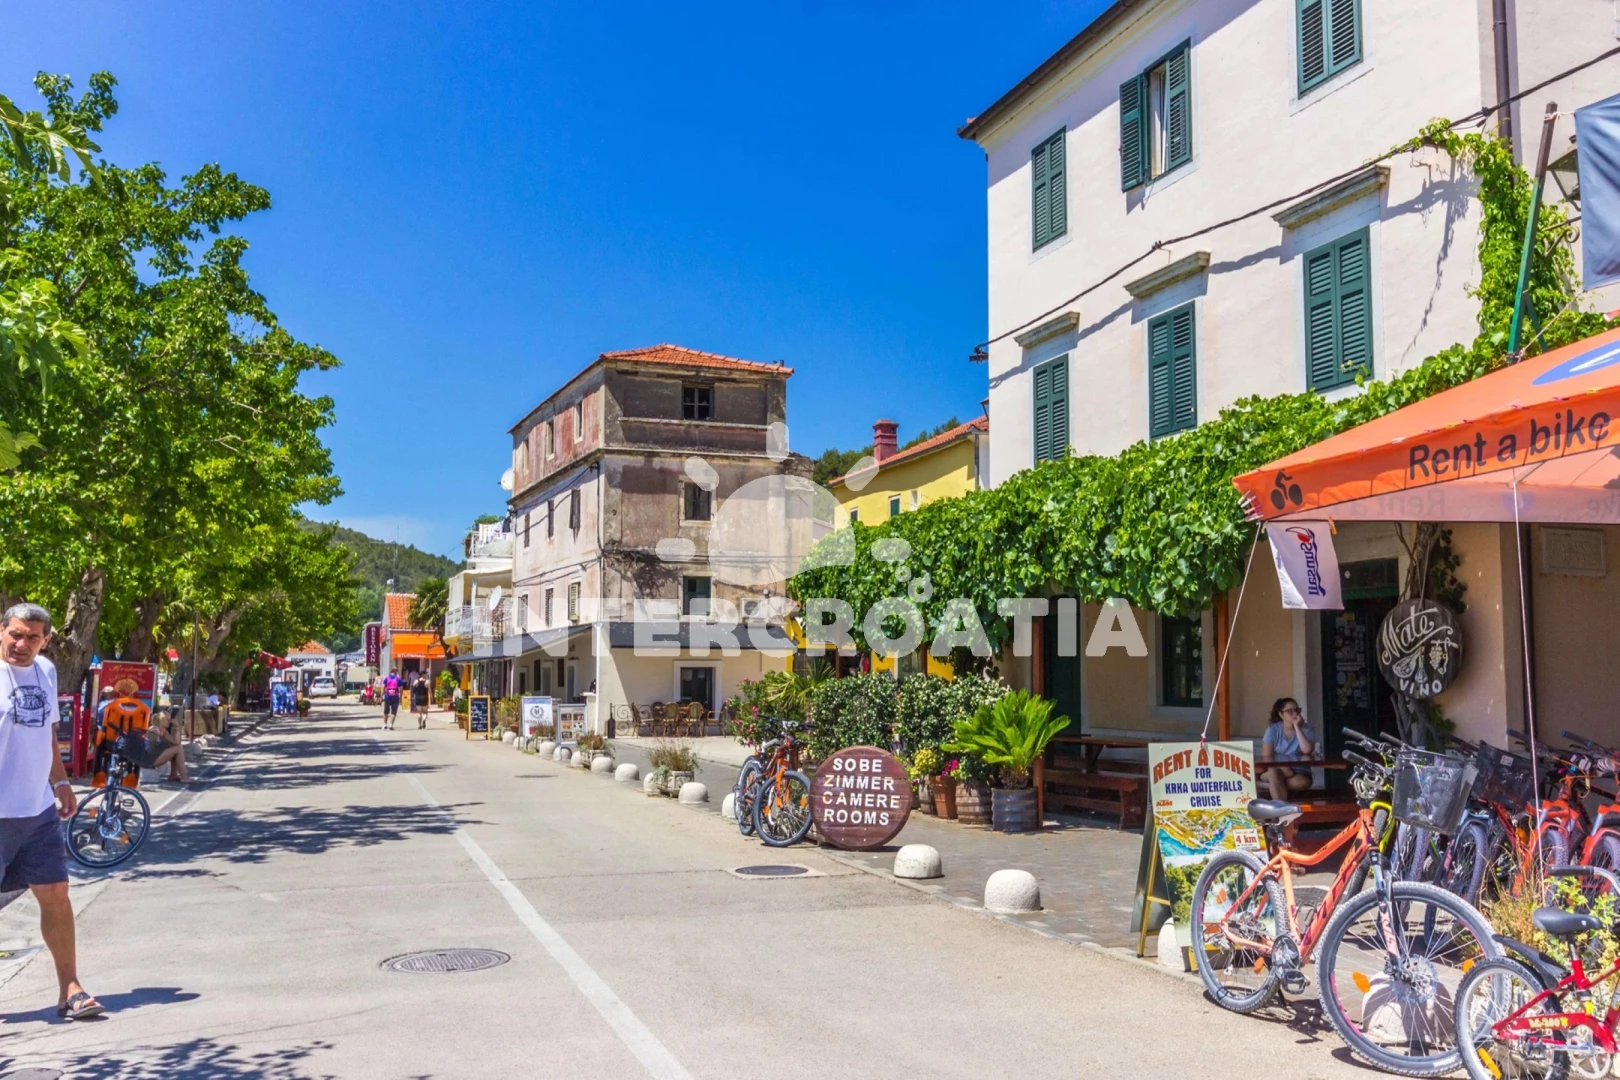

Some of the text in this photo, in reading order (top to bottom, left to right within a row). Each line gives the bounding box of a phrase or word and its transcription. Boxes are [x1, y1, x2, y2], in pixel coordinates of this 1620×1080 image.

[1409, 409, 1611, 481] Rent a bike
[1381, 605, 1453, 665] Mate
[1400, 679, 1442, 695] VINO
[832, 758, 882, 772] SOBE
[1153, 748, 1251, 784] RENT A BIKE
[1195, 767, 1211, 779] FOR
[823, 775, 895, 791] ZIMMER
[1165, 780, 1243, 794] KRKA WATERFALLS
[822, 791, 900, 809] CAMERE
[1190, 795, 1222, 808] CRUISE
[823, 809, 890, 826] ROOMS
[1235, 834, 1257, 844] 4 km
